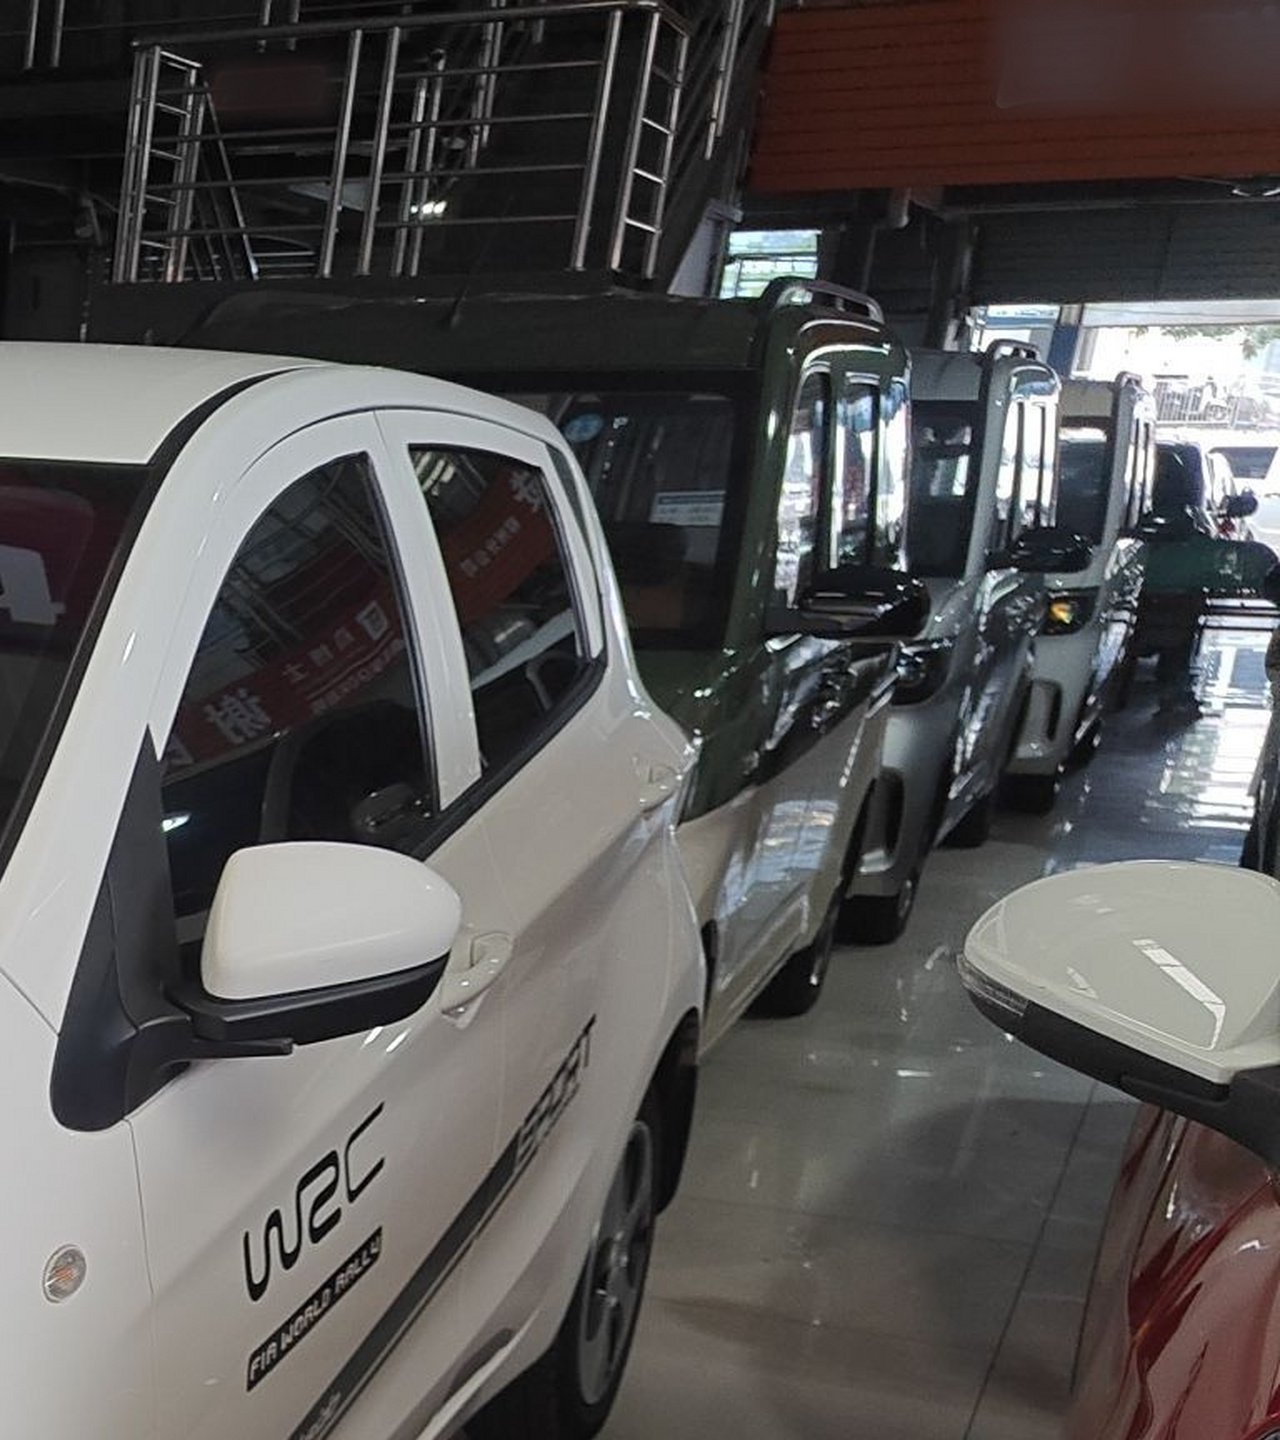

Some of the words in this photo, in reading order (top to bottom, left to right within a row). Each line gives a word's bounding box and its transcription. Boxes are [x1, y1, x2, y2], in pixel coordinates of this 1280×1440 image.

[243, 1101, 385, 1302] WRC
[250, 1341, 278, 1382] FIA
[281, 1288, 332, 1351] WORLD
[335, 1235, 382, 1295] RALLY
